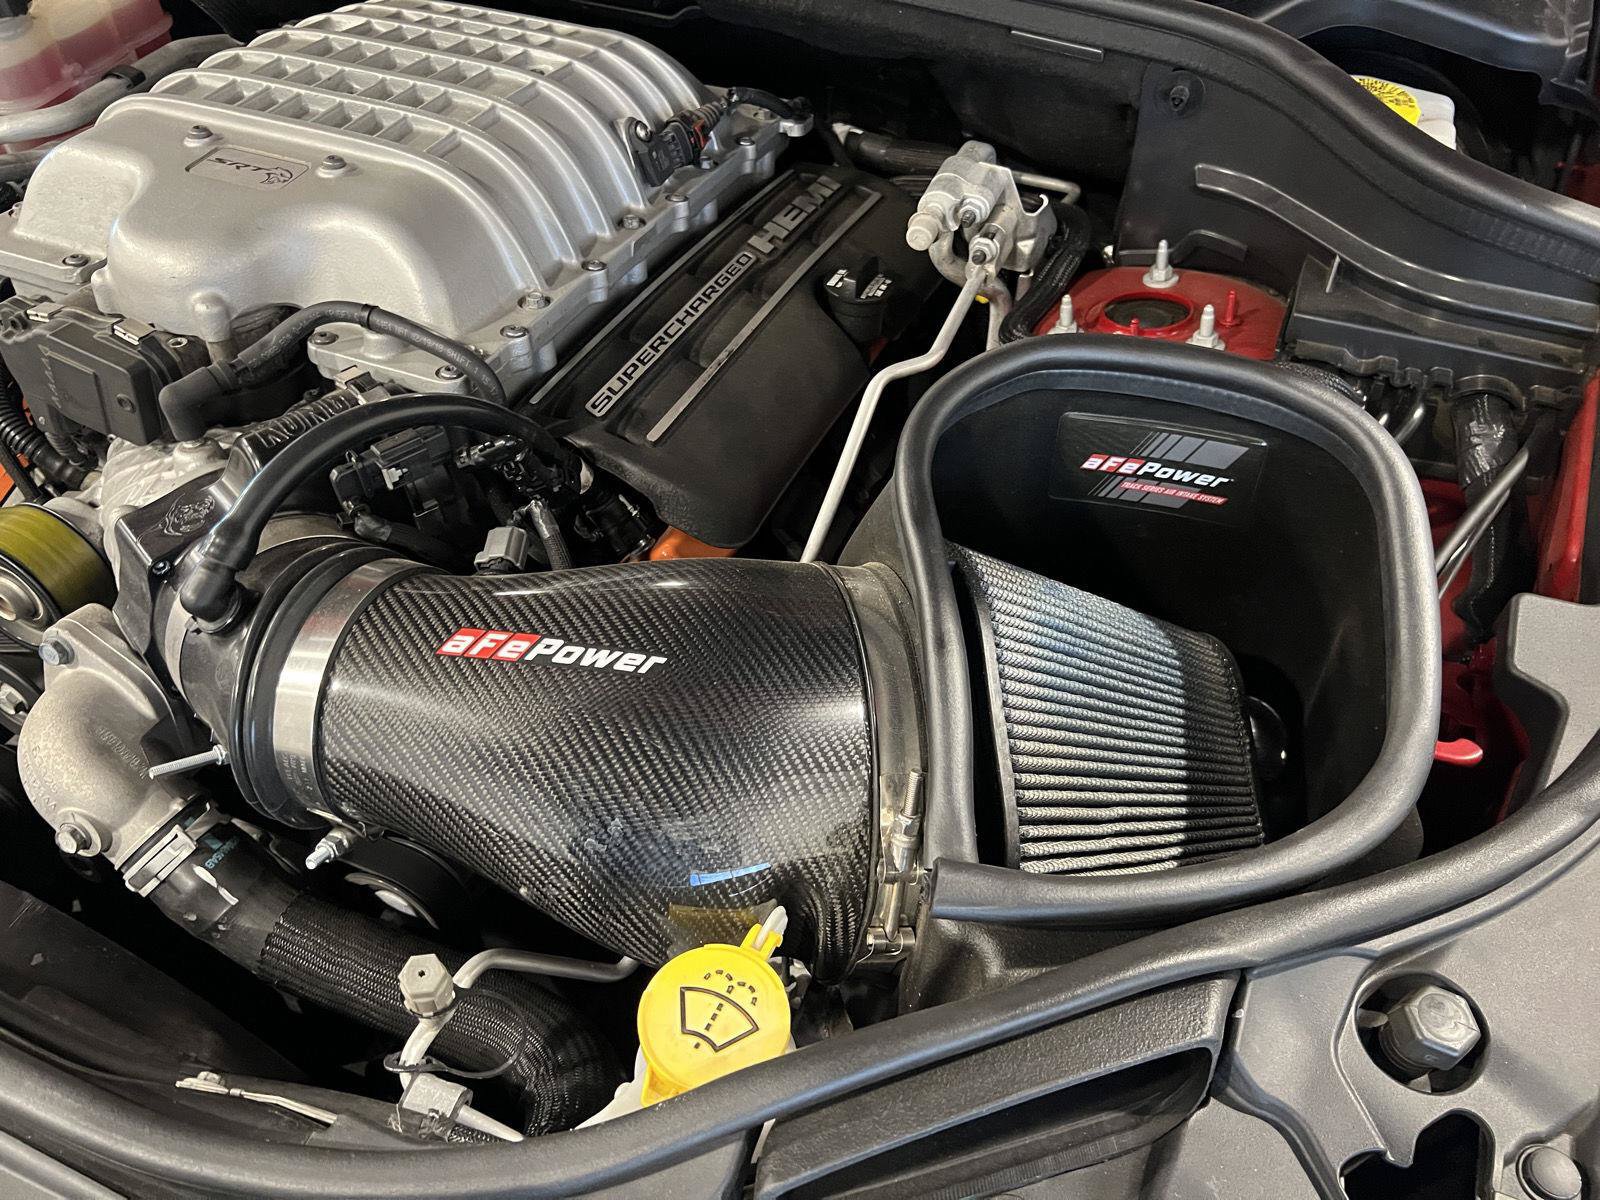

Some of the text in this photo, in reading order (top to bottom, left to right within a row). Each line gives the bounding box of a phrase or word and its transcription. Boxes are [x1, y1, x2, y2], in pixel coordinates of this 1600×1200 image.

[588, 175, 842, 414] SUPERCHARGED HEMI
[1121, 481, 1225, 504] TRACK SERIES AIR INTAKE SYSTEM
